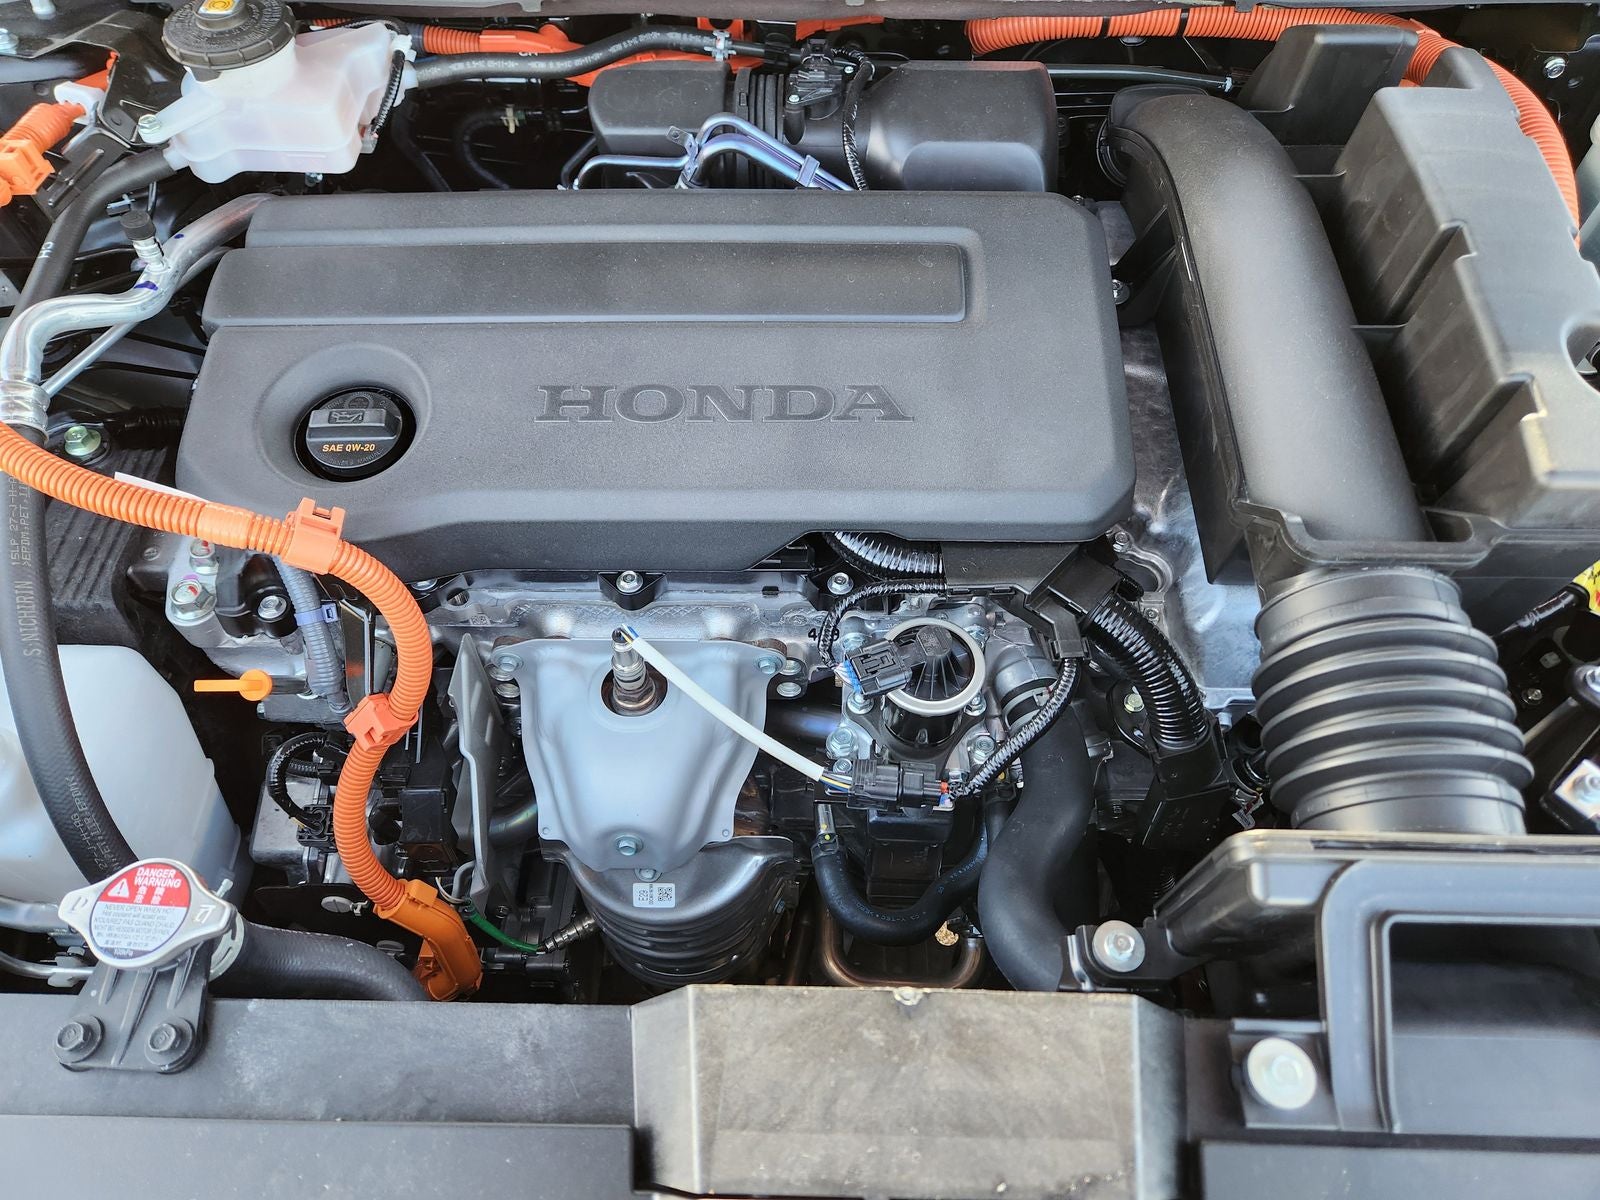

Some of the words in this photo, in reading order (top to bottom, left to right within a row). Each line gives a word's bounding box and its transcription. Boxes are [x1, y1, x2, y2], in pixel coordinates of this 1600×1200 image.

[534, 384, 914, 423] HONDA
[322, 443, 344, 452] SAE
[345, 443, 376, 452] 0W-20
[8, 474, 19, 532] 27-J-H-A
[137, 867, 176, 879] DANGER
[134, 876, 182, 889] WARNUNG
